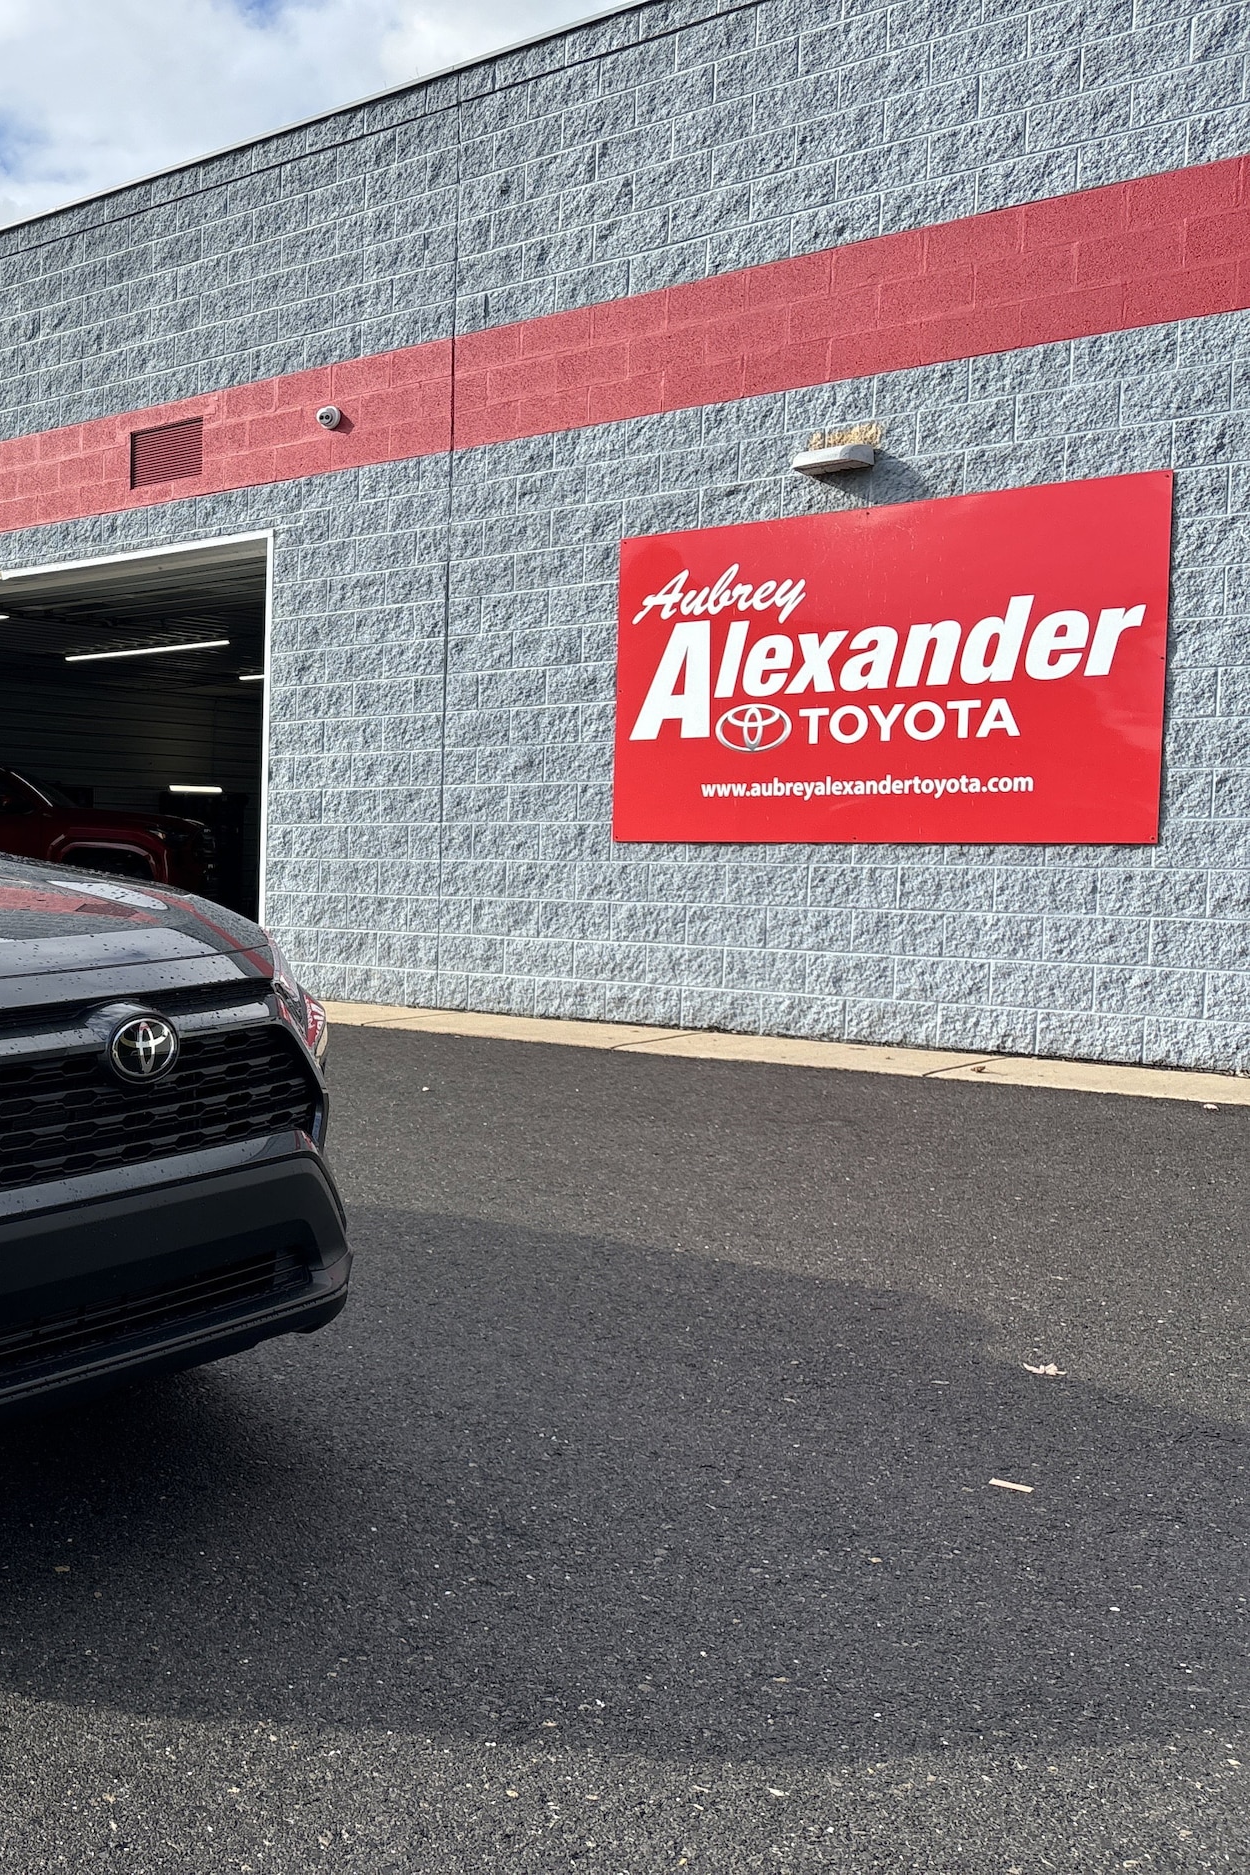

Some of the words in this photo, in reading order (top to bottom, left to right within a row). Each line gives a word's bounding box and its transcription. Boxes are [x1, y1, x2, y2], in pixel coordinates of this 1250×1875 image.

[632, 563, 806, 625] Aubrey
[629, 594, 1147, 741] Alexander
[799, 698, 1021, 745] TOYOTA
[701, 774, 1034, 801] www.aubreyalexandertoyota.com
